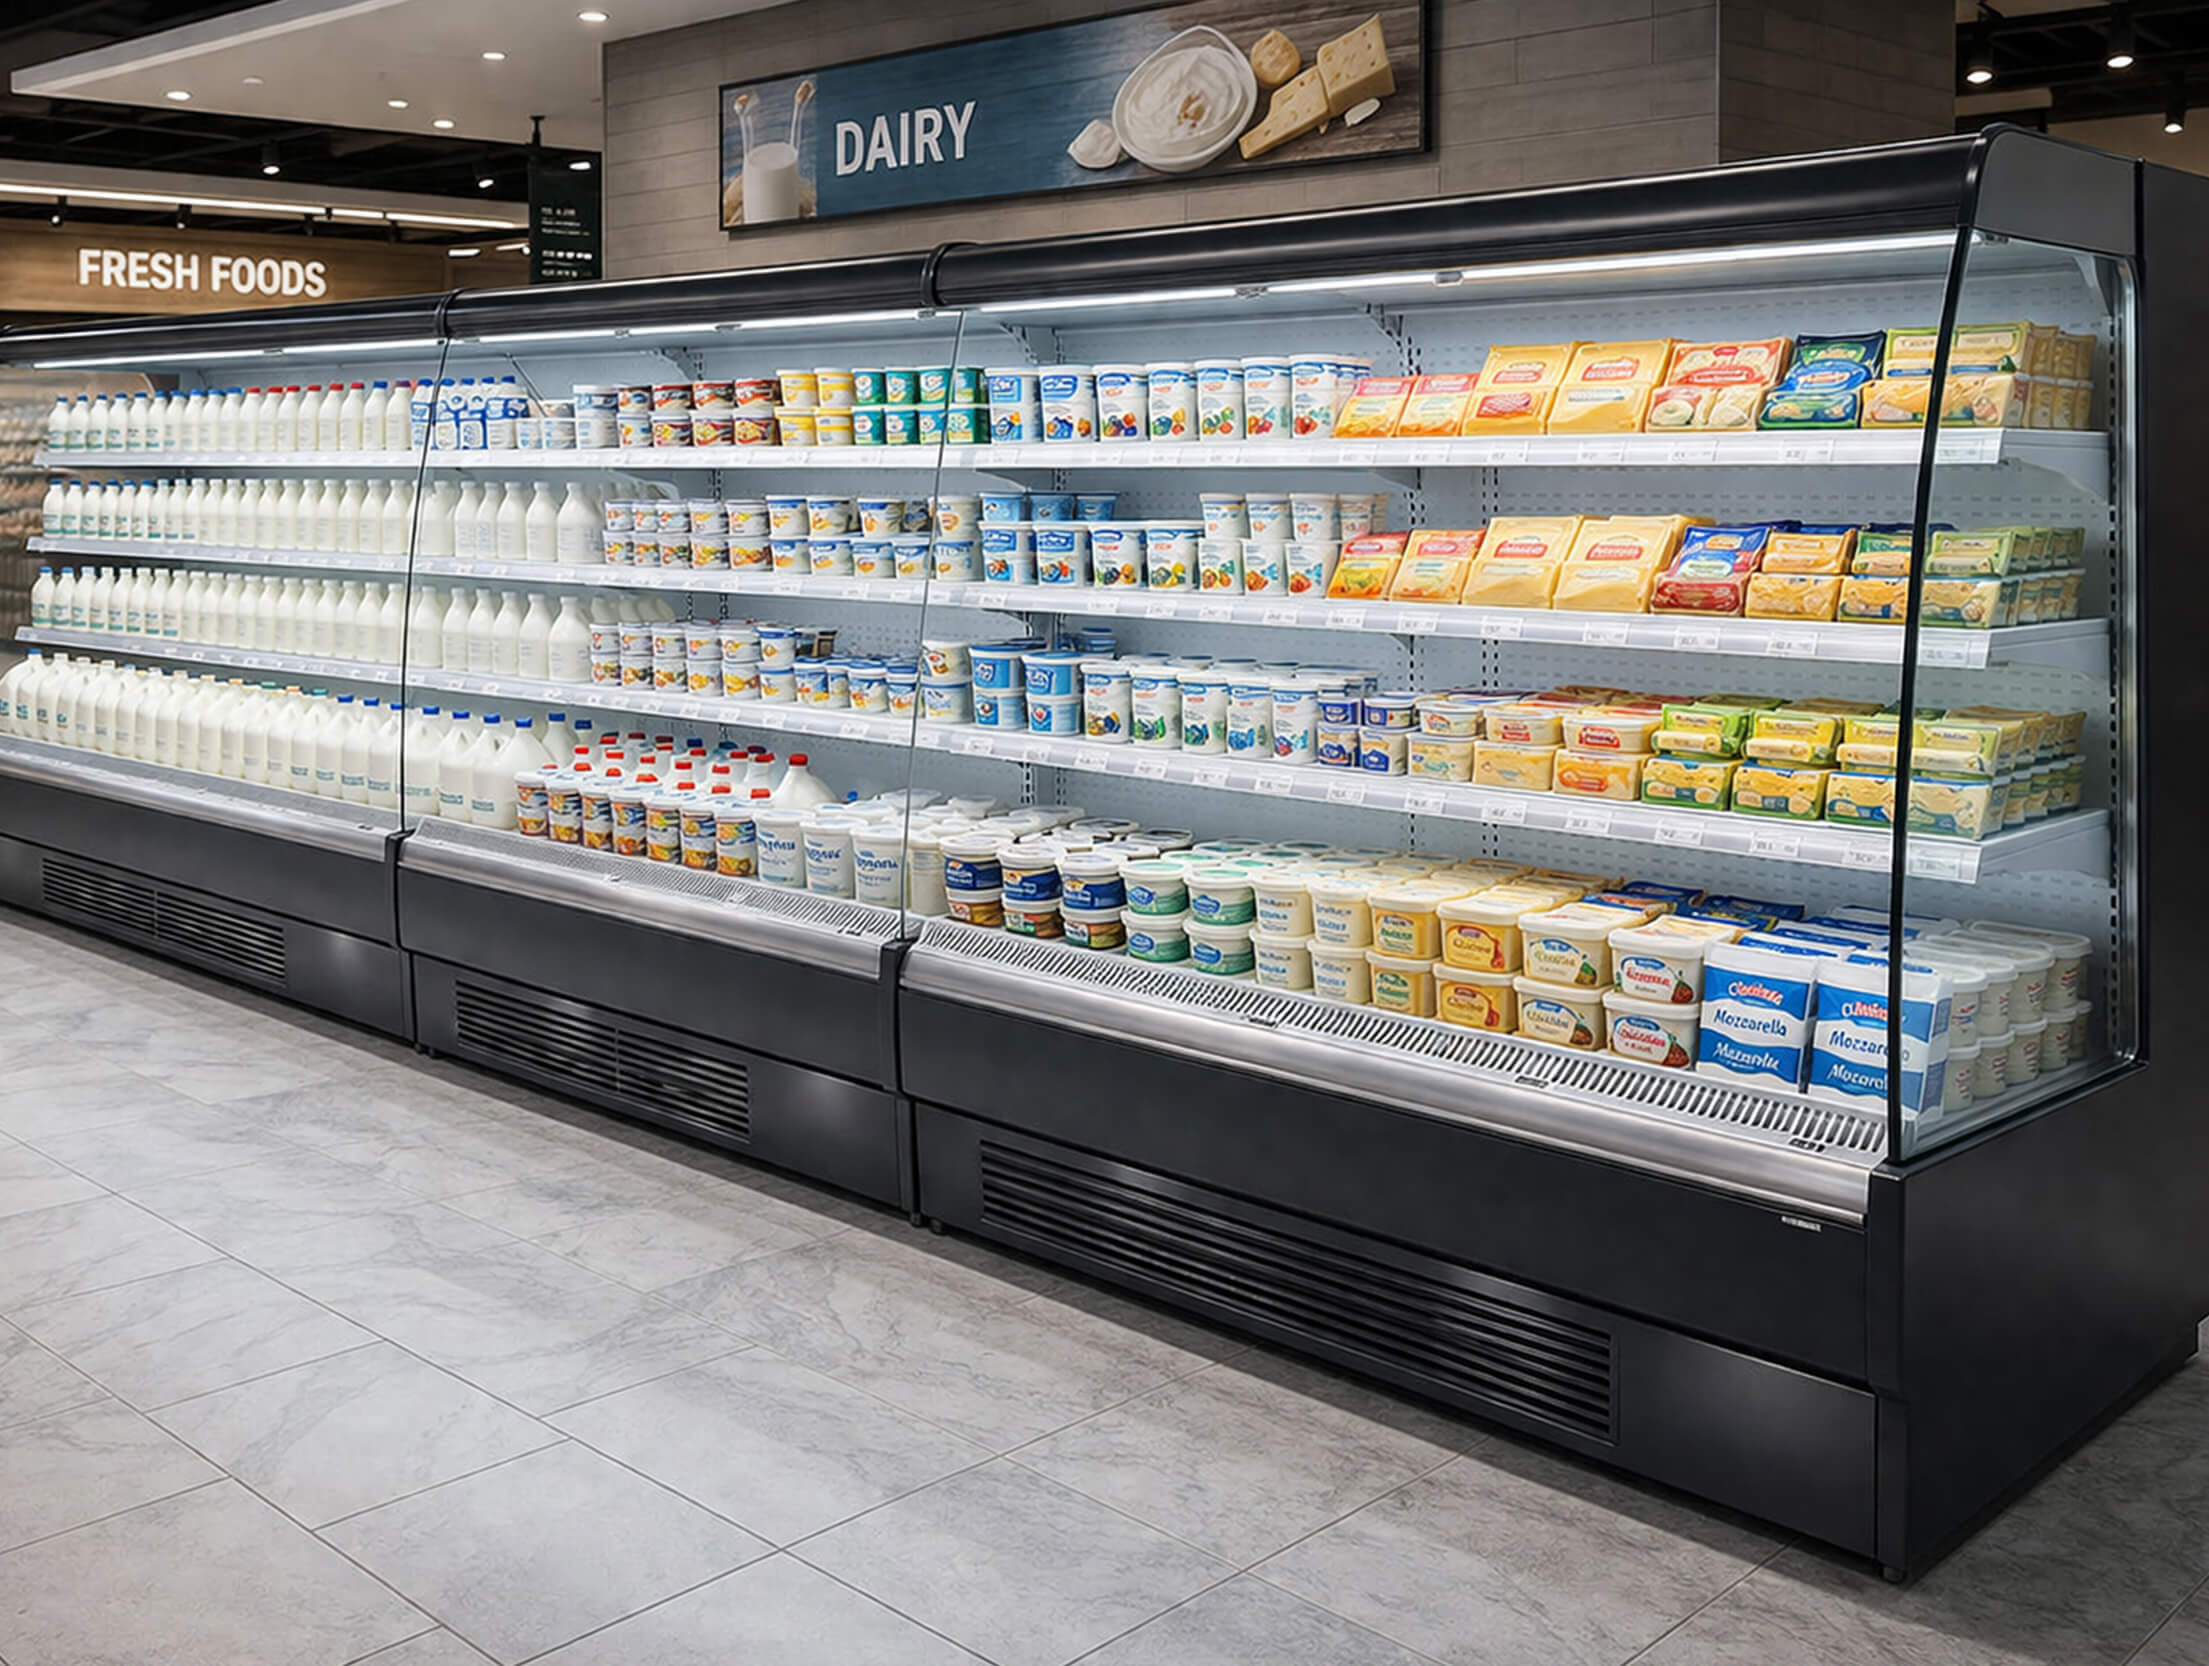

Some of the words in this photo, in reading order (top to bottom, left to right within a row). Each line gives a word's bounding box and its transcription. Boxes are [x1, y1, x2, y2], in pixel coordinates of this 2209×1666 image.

[836, 100, 976, 176] DAIRY
[79, 248, 199, 292] FRESH
[211, 256, 326, 298] FOODS
